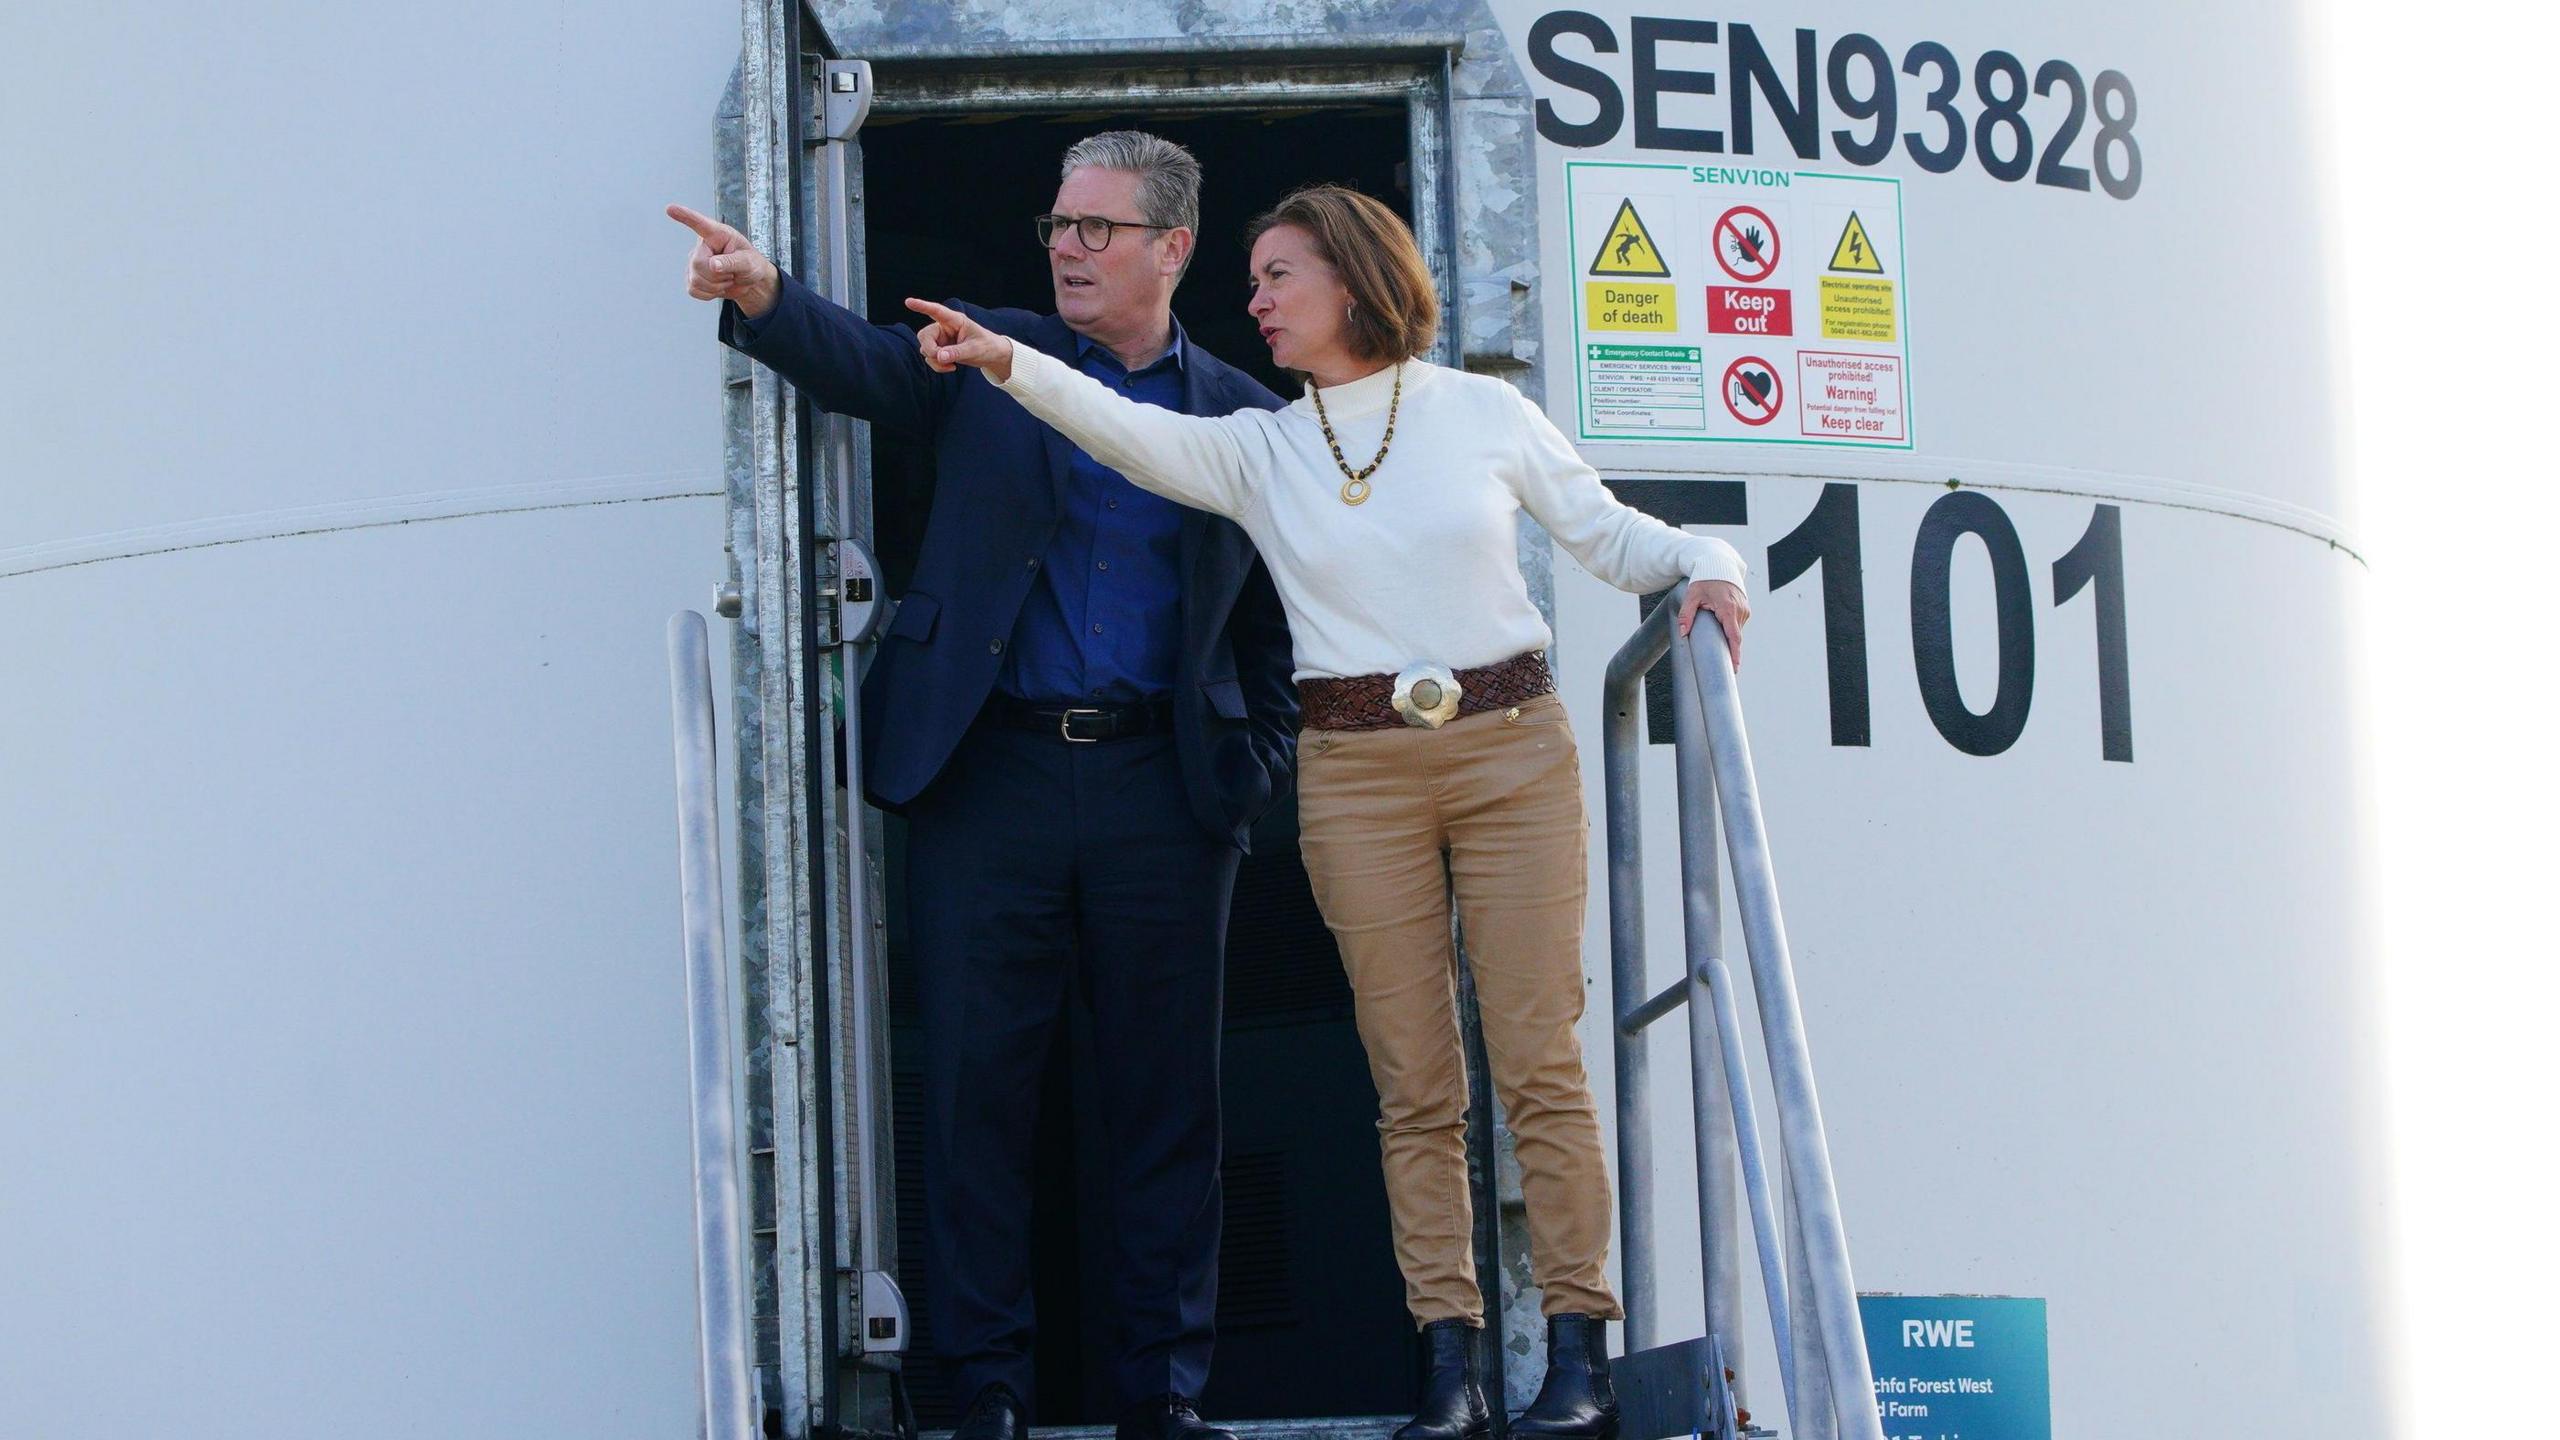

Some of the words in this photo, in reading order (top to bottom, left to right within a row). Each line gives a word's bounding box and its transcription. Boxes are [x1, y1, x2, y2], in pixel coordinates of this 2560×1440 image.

[1527, 9, 2143, 201] SEN93828
[1822, 280, 1850, 288] Electrical
[1605, 289, 1659, 307] Danger
[1724, 290, 1776, 316] Keep
[1833, 294, 1882, 305] Unauthorised
[1603, 309, 1618, 323] of
[1622, 310, 1663, 324] death
[1825, 306, 1851, 314] access
[1852, 306, 1891, 316] prohibited!
[1734, 315, 1768, 333] out
[1837, 320, 1871, 328] registration
[1605, 349, 1639, 358] Emergency
[1664, 350, 1686, 358] Details
[1806, 357, 1862, 370] Unauthorised
[1864, 362, 1894, 372] access
[1828, 370, 1873, 383] prohibited!
[1825, 385, 1878, 405] Warning!
[1806, 403, 1832, 411] Potential
[1833, 405, 1853, 414] danger
[1868, 407, 1885, 416] falling
[1821, 414, 1852, 432] Keep
[1855, 417, 1884, 432] clear
[1902, 1319, 1975, 1348] RWE
[1874, 1377, 1906, 1394] chfa
[1909, 1377, 1956, 1394] Forest
[1958, 1377, 1993, 1394] West
[1889, 1402, 1928, 1417] Farm
